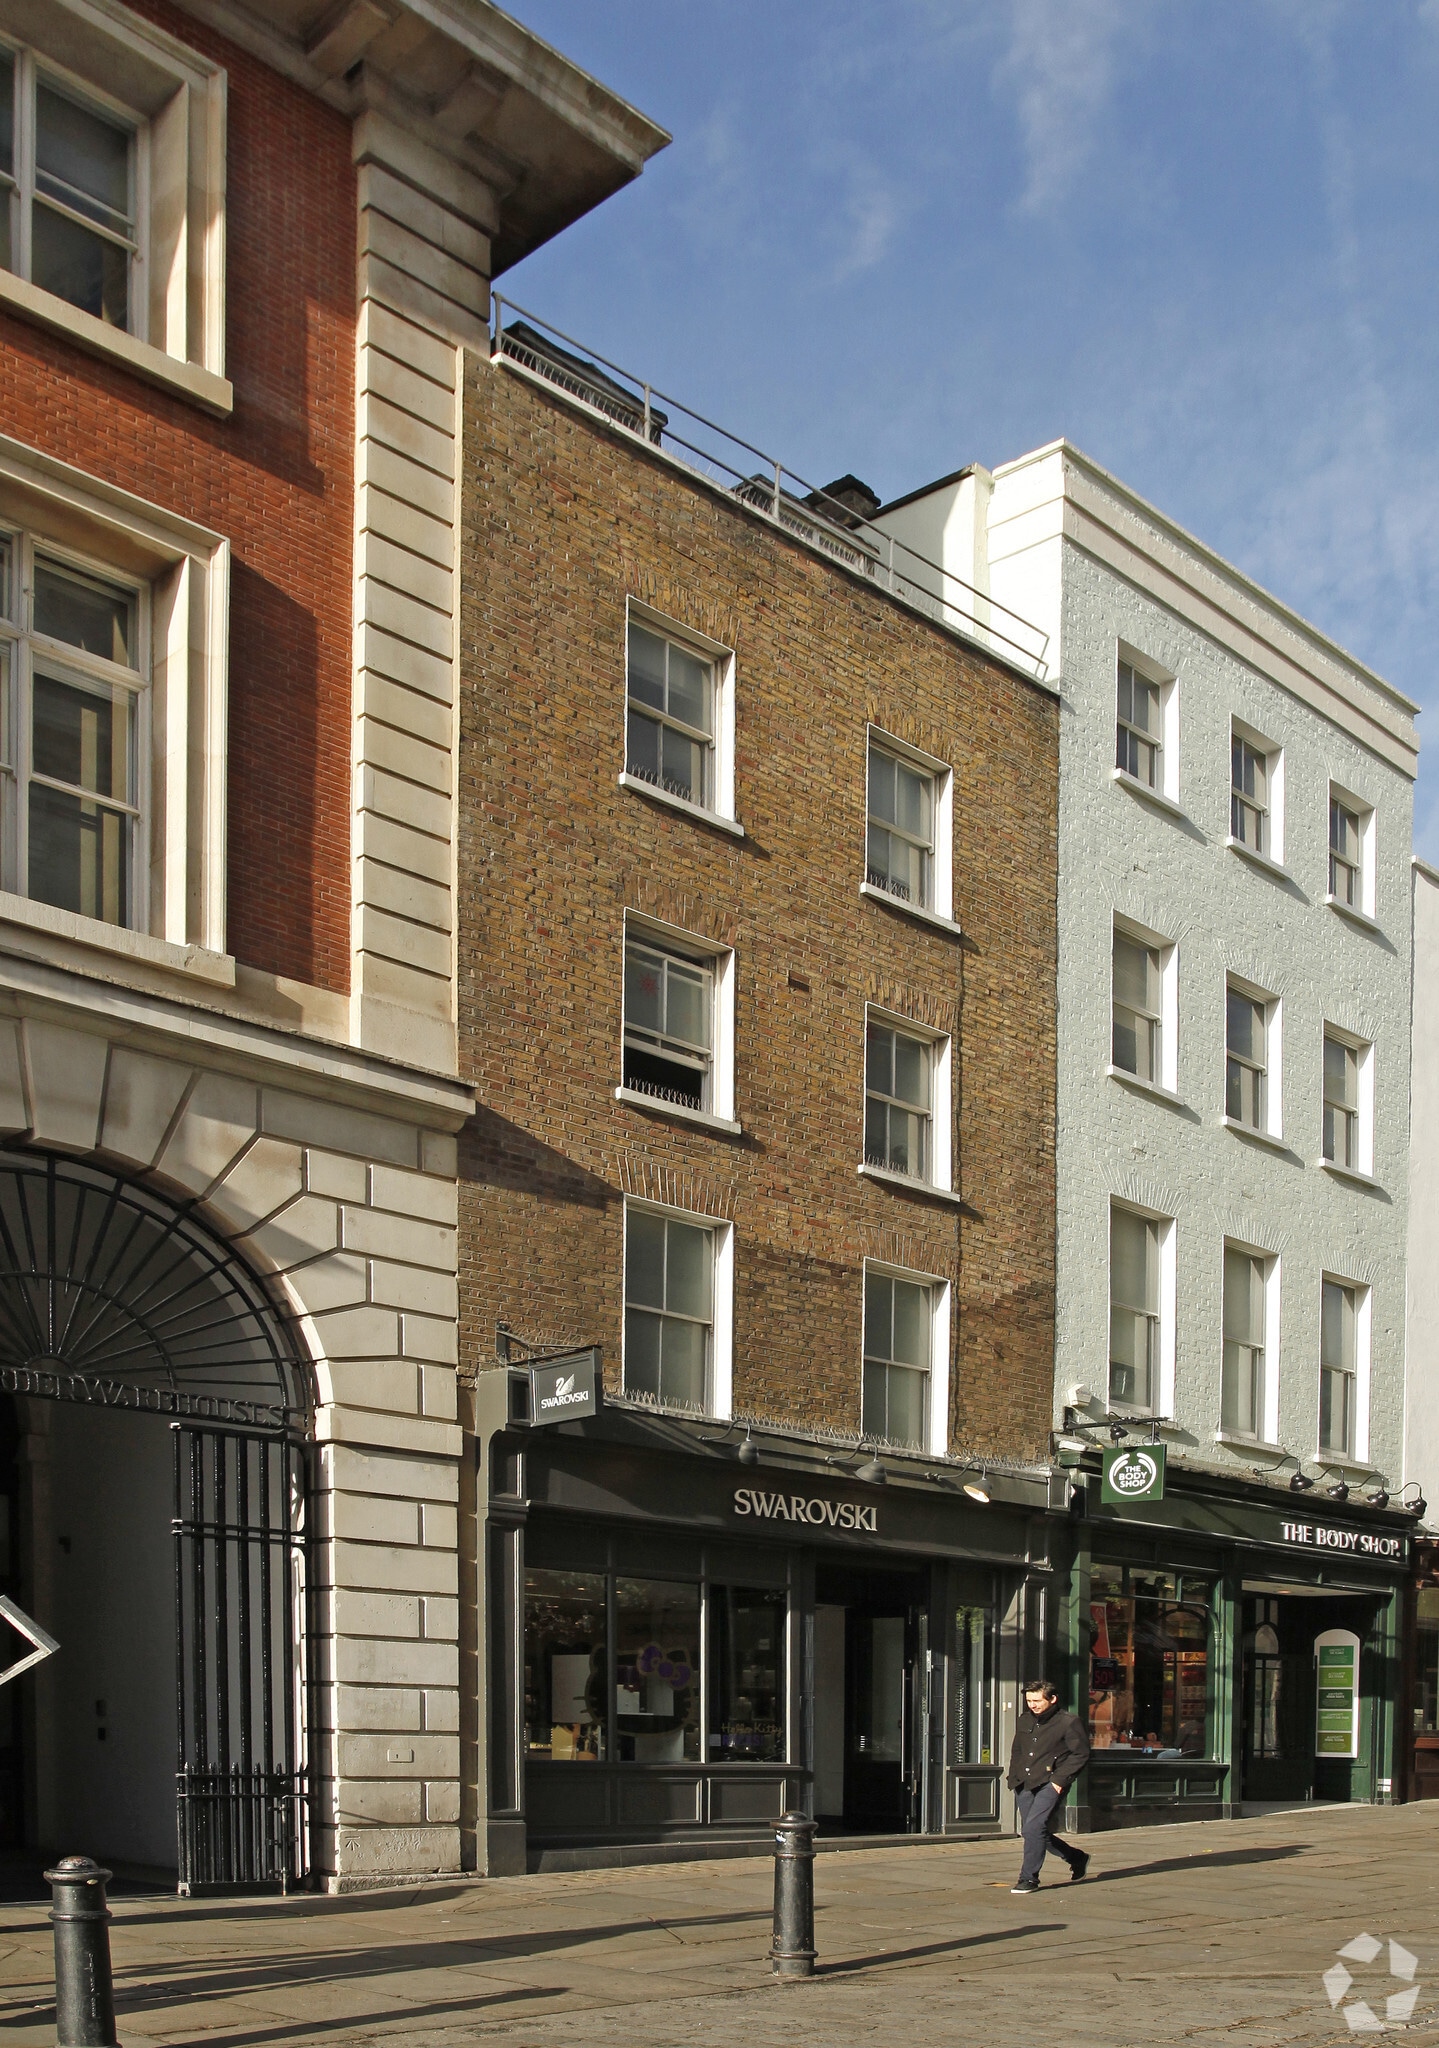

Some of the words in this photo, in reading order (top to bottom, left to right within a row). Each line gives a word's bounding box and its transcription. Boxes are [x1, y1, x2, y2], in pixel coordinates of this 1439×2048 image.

[76, 1374, 285, 1428] WAREHOUSES
[541, 1391, 589, 1409] SWAROVSKI
[1118, 1471, 1148, 1481] BODY
[1124, 1465, 1141, 1473] THE
[1119, 1479, 1146, 1488] SHOP
[734, 1488, 878, 1532] SWAROVSKI
[1280, 1521, 1313, 1544] THE
[1315, 1526, 1359, 1550] BODY
[721, 1722, 752, 1733] Hello
[754, 1722, 783, 1737] Kitty
